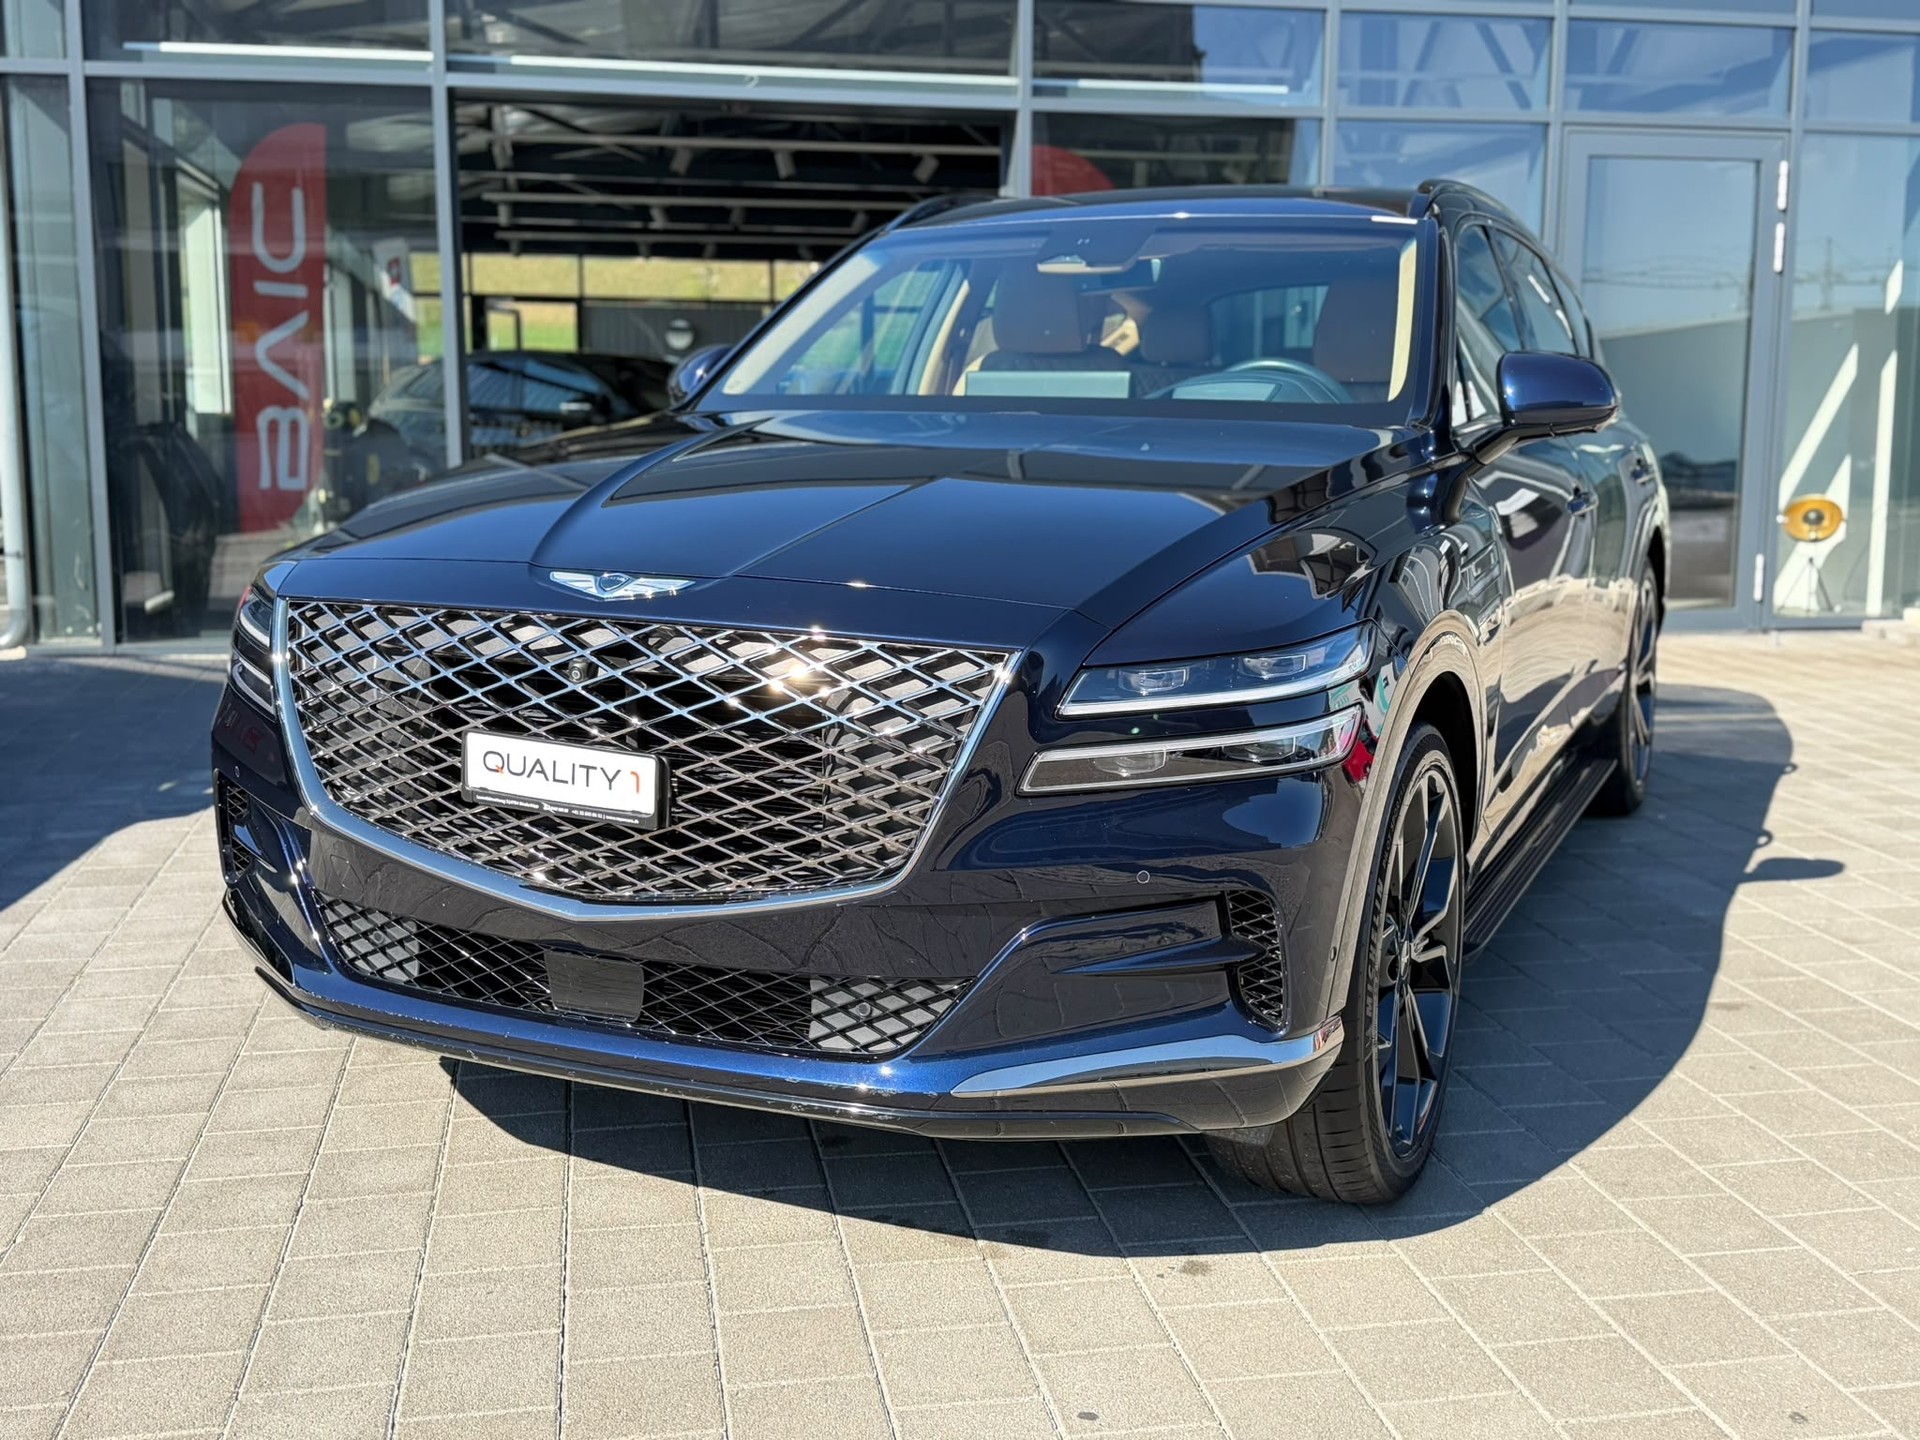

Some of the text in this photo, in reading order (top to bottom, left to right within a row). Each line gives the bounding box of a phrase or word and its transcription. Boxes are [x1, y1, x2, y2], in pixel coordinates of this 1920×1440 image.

[252, 182, 309, 490] BAIC
[483, 751, 640, 794] QUALITY 1
[1366, 878, 1383, 1017] MICHELIN
